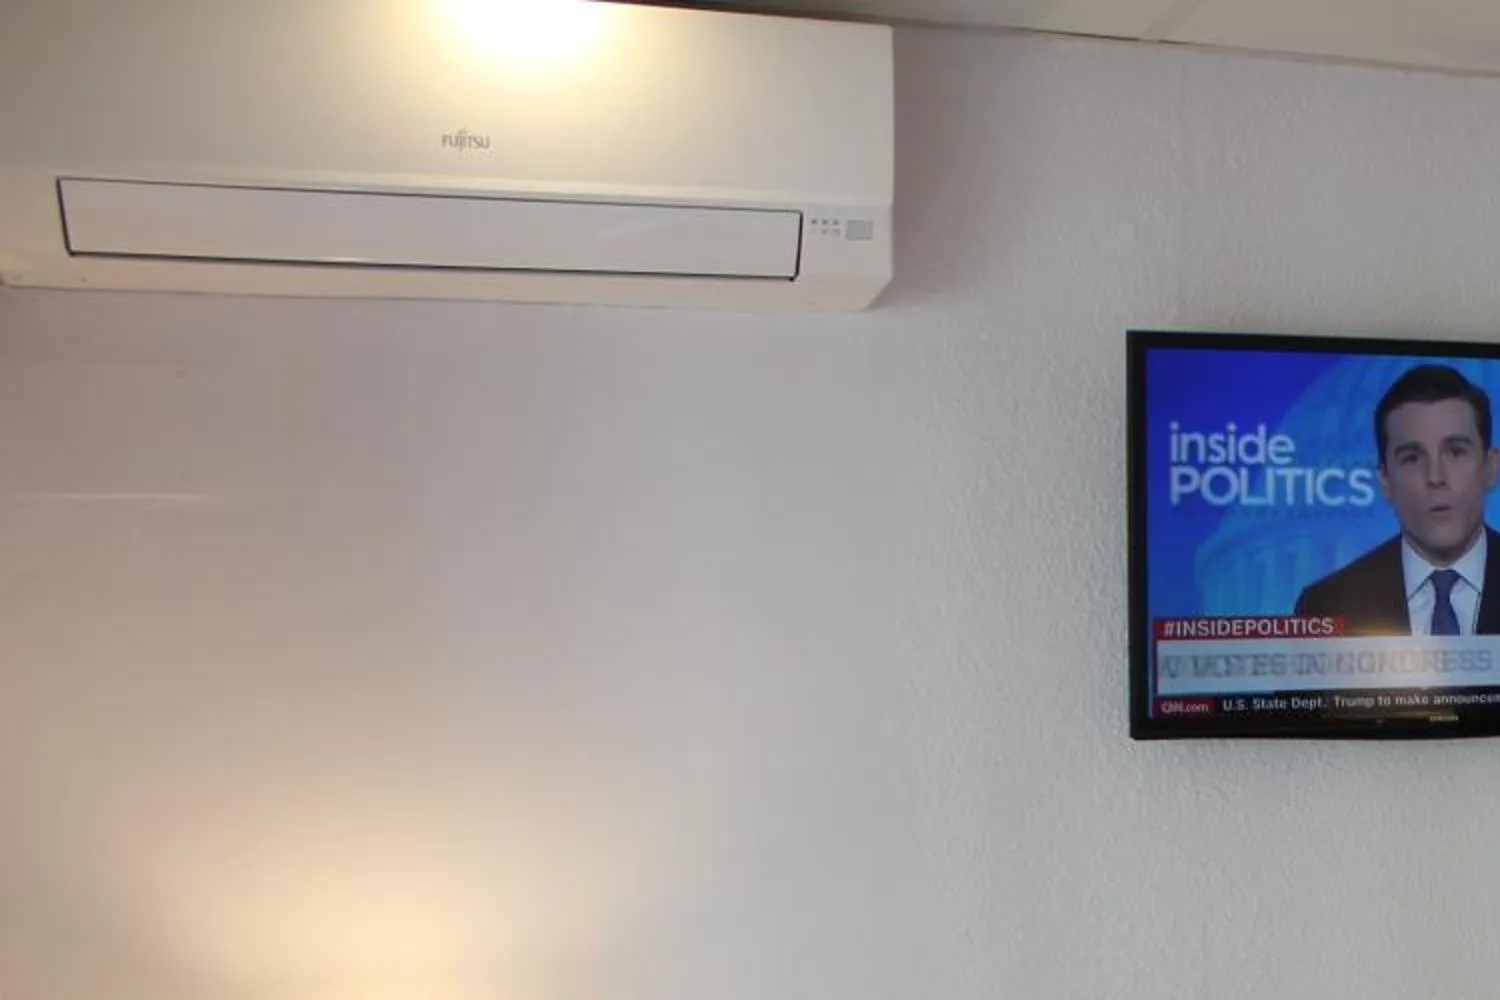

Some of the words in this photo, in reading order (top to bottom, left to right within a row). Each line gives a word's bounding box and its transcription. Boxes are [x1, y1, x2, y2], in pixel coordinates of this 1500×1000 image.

[441, 128, 491, 151] FUJITSU
[1169, 420, 1296, 465] inside
[1169, 465, 1375, 507] POLITICS
[1164, 617, 1334, 637] #INSIDEPOLITICS
[1222, 699, 1248, 712] U.S.
[1252, 697, 1288, 710] State
[1333, 694, 1375, 709] Trump
[1377, 695, 1391, 706] to
[1395, 693, 1429, 706] make
